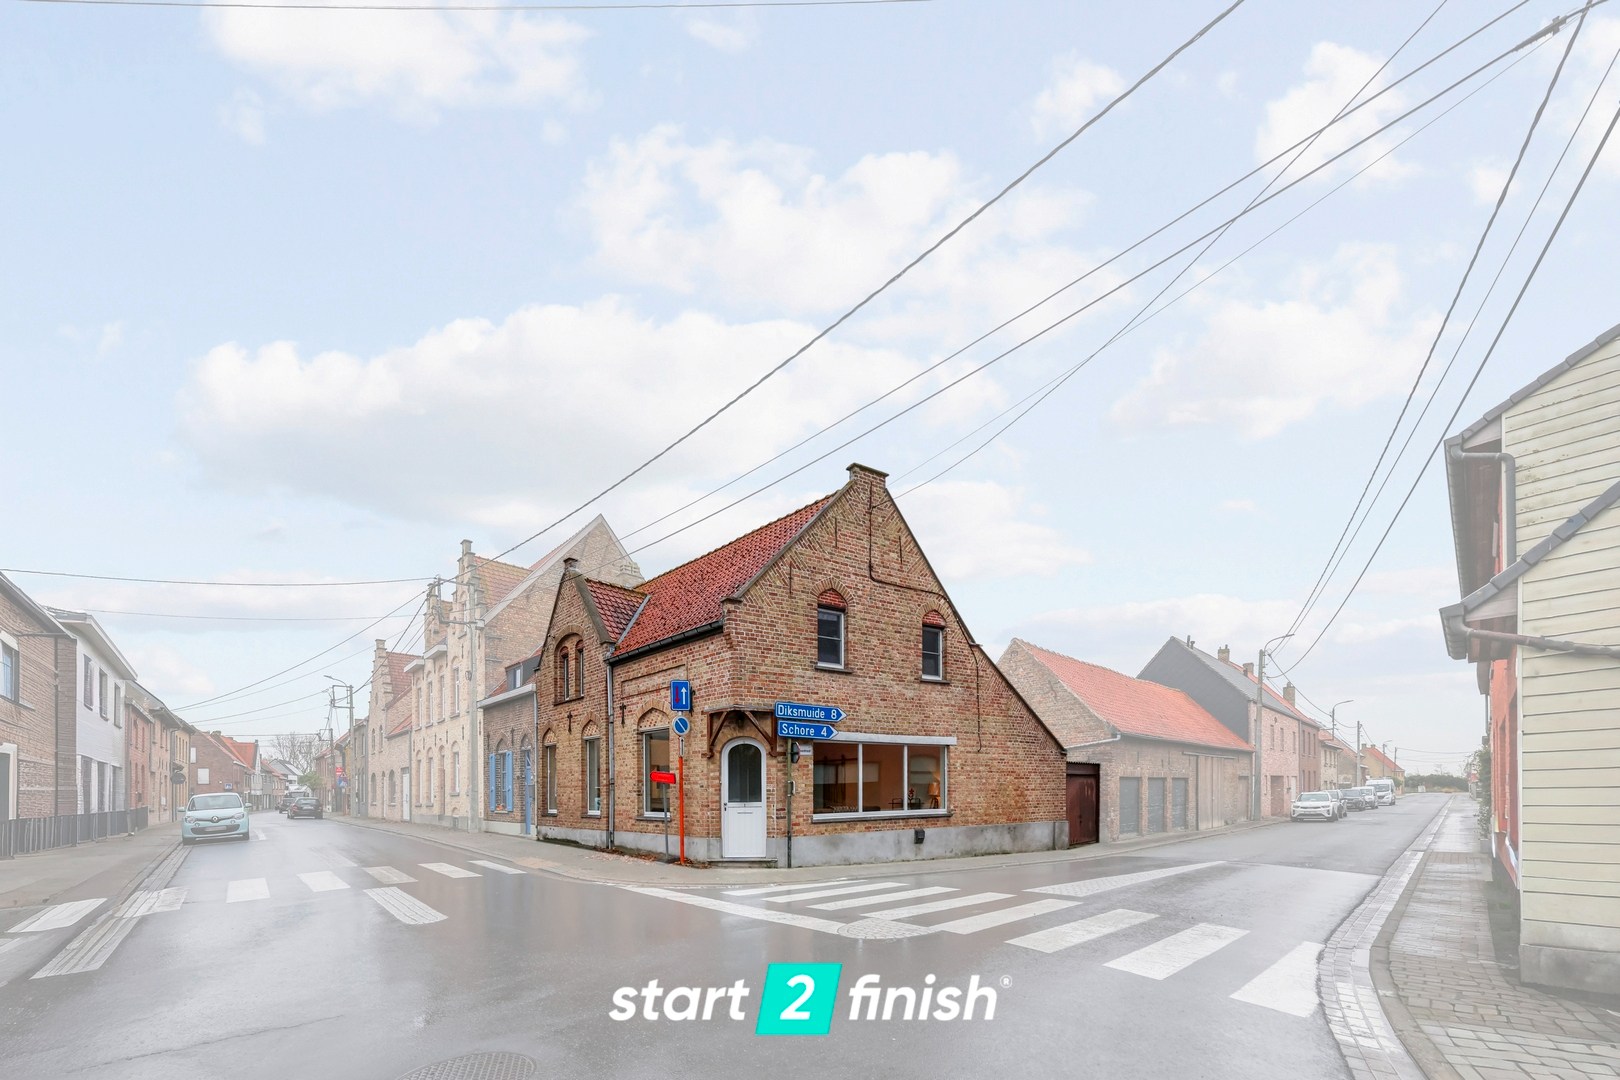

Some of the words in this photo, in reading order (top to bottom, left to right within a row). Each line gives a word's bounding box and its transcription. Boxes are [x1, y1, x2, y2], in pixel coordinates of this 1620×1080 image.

[778, 704, 825, 719] Diksmuide
[831, 709, 837, 720] 8
[782, 723, 815, 736] Schore
[820, 726, 828, 737] 4
